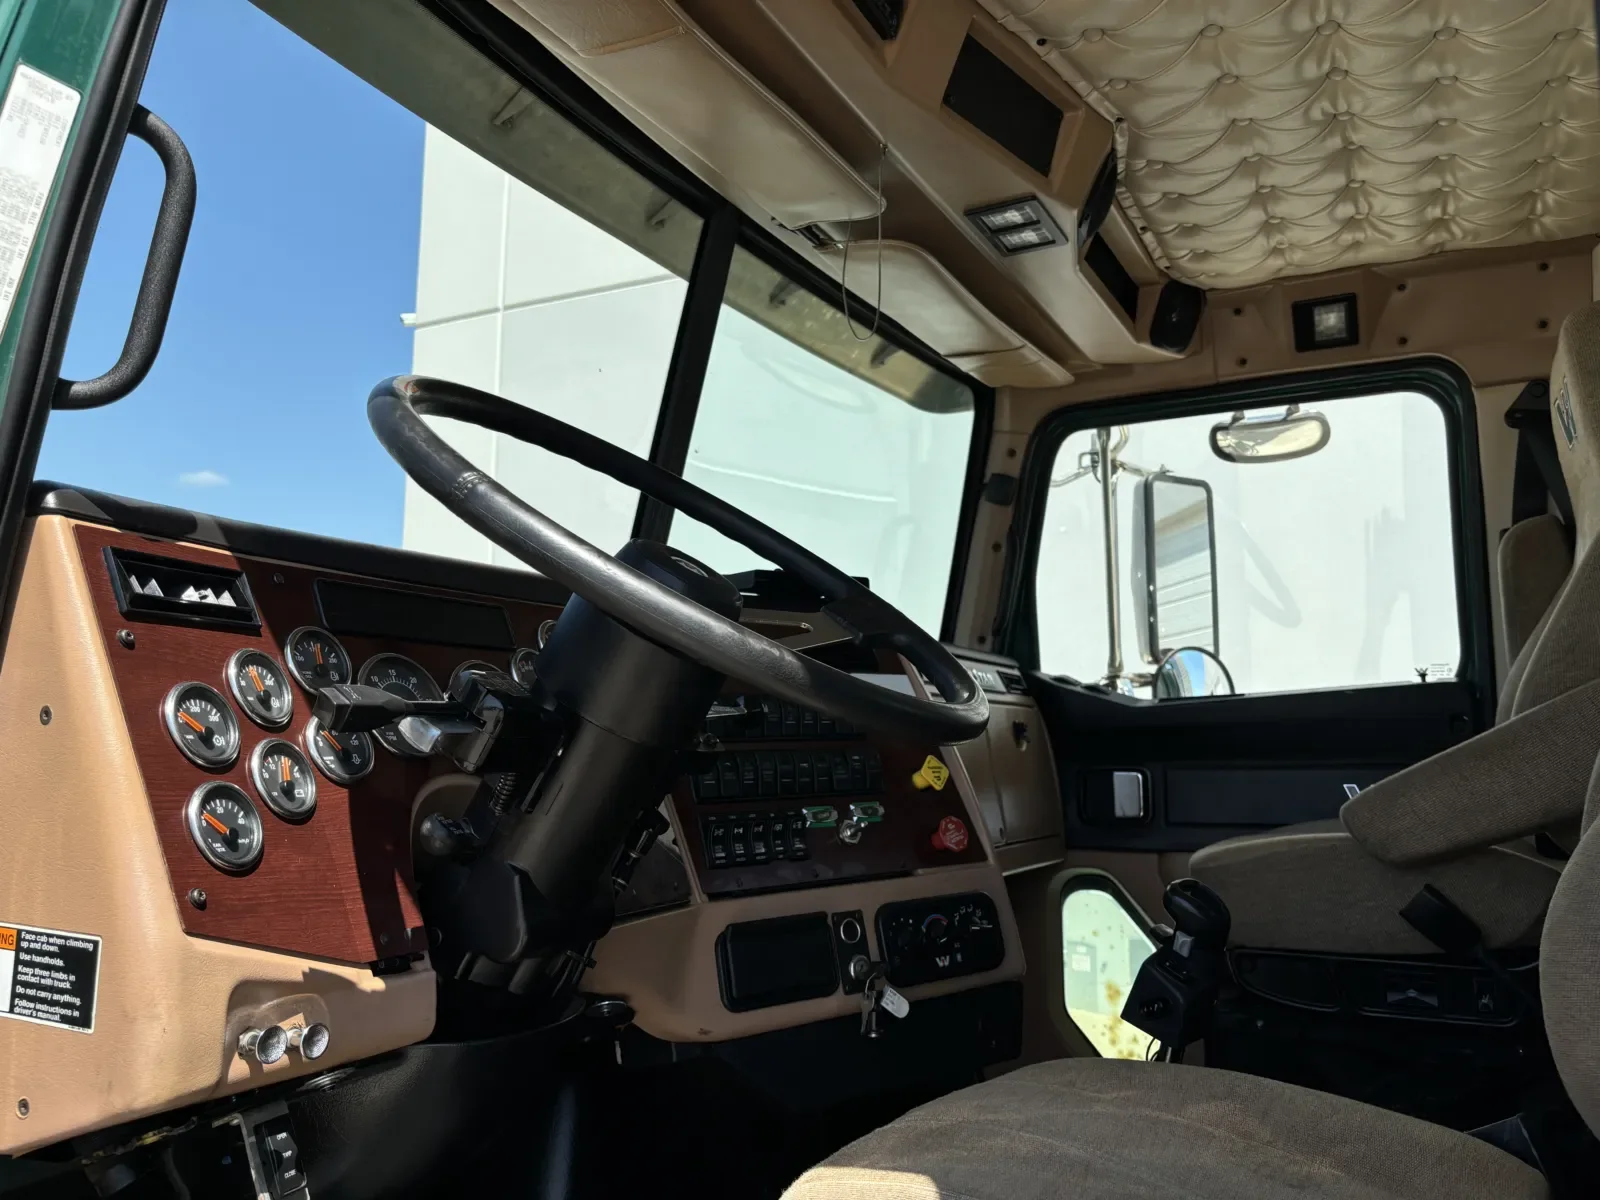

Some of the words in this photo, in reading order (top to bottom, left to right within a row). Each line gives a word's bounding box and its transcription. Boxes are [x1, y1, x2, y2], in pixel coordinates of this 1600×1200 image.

[21, 932, 36, 941] Face
[36, 934, 48, 942] cab
[48, 936, 65, 945] when
[66, 938, 94, 950] climbing
[30, 942, 42, 950] and
[42, 943, 60, 952] down.
[20, 952, 31, 960] Use
[32, 954, 65, 966] handholds.
[17, 974, 40, 984] contact
[40, 976, 54, 985] with
[54, 979, 72, 988] truck.
[18, 965, 34, 975] Keep
[34, 968, 50, 976] three
[50, 970, 68, 980] limbs
[69, 973, 76, 981] in
[26, 988, 36, 996] not
[36, 990, 52, 1000] carry
[52, 992, 82, 1005] anything.
[14, 998, 35, 1008] Follow
[36, 1002, 72, 1016] instructions
[73, 1008, 80, 1017] in
[14, 1006, 36, 1016] driver's
[37, 1011, 62, 1022] manual.
